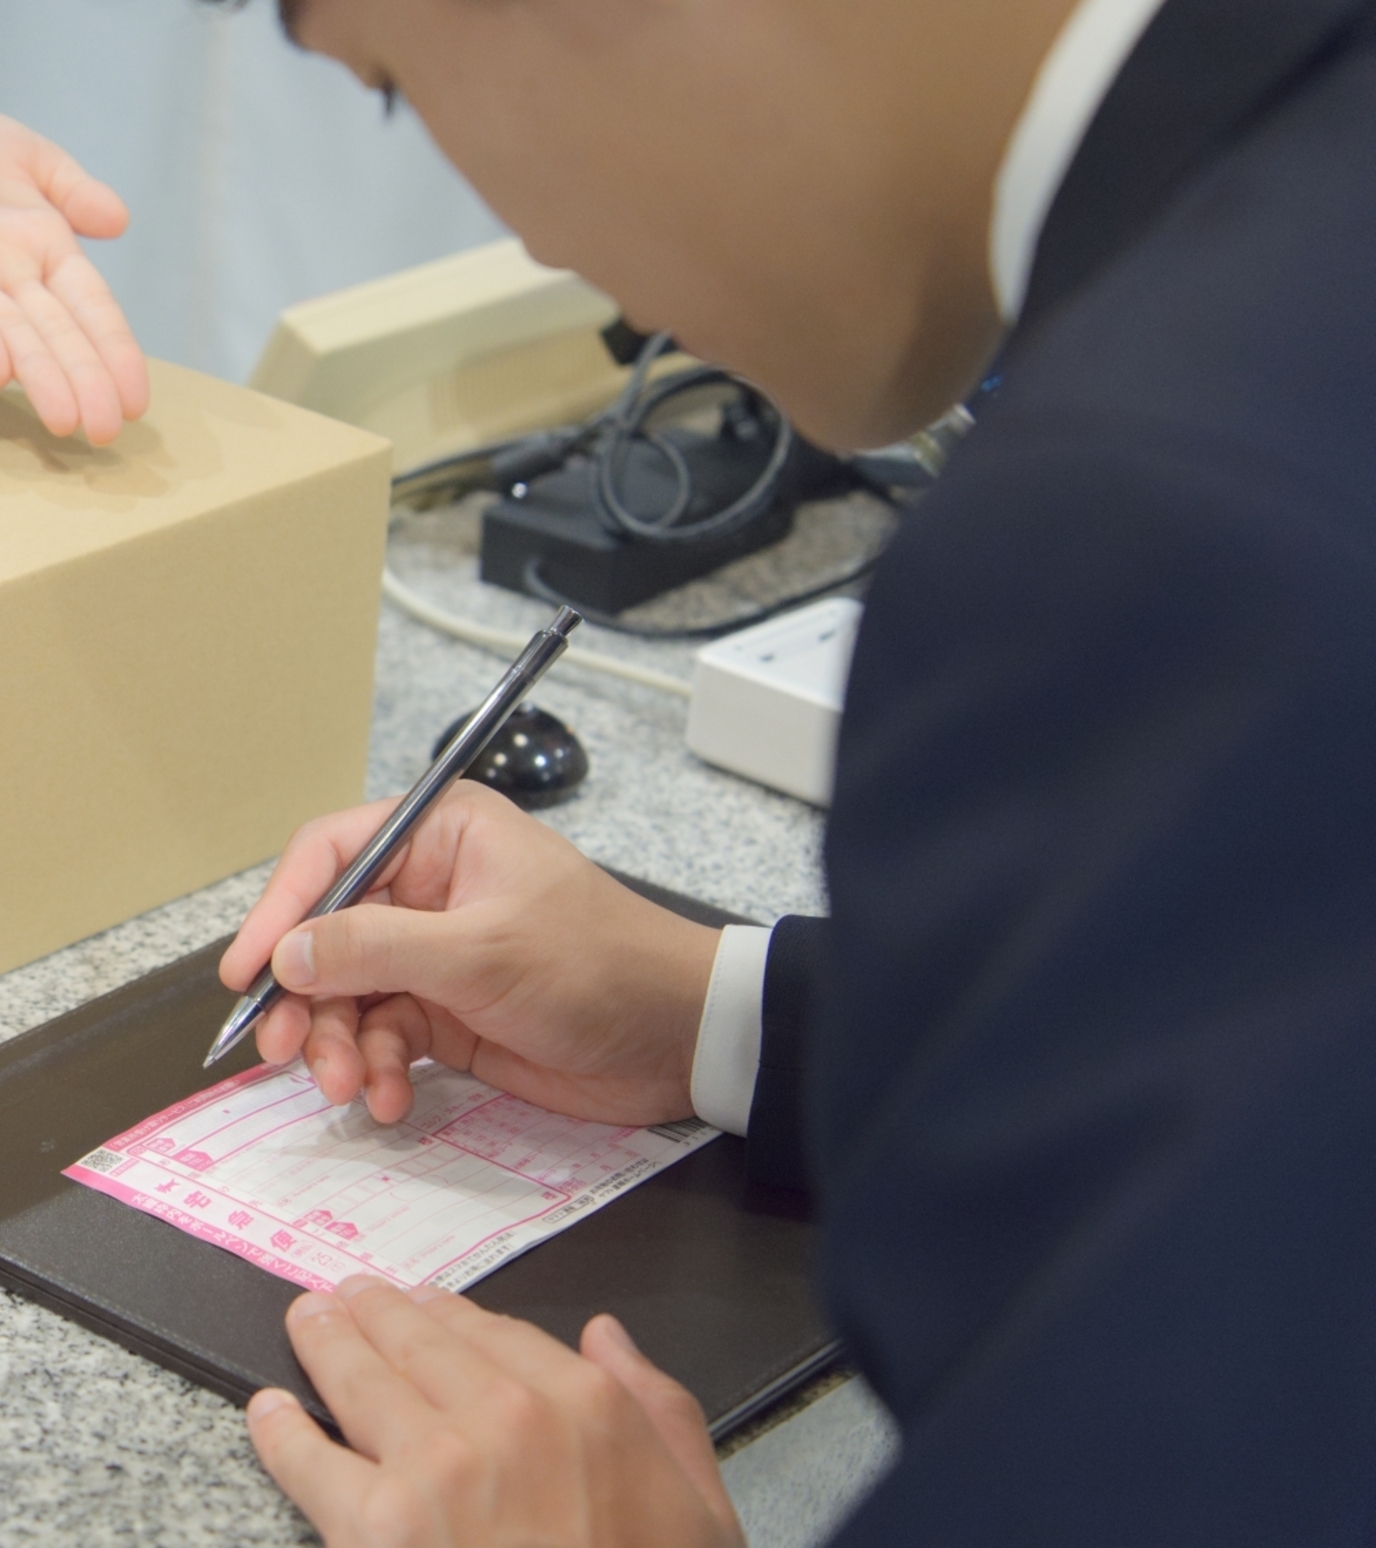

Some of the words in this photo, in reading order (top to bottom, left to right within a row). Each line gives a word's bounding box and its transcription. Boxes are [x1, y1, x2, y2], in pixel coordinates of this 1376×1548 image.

[183, 1190, 298, 1252] 宅急便
[311, 1251, 333, 1267] 25
